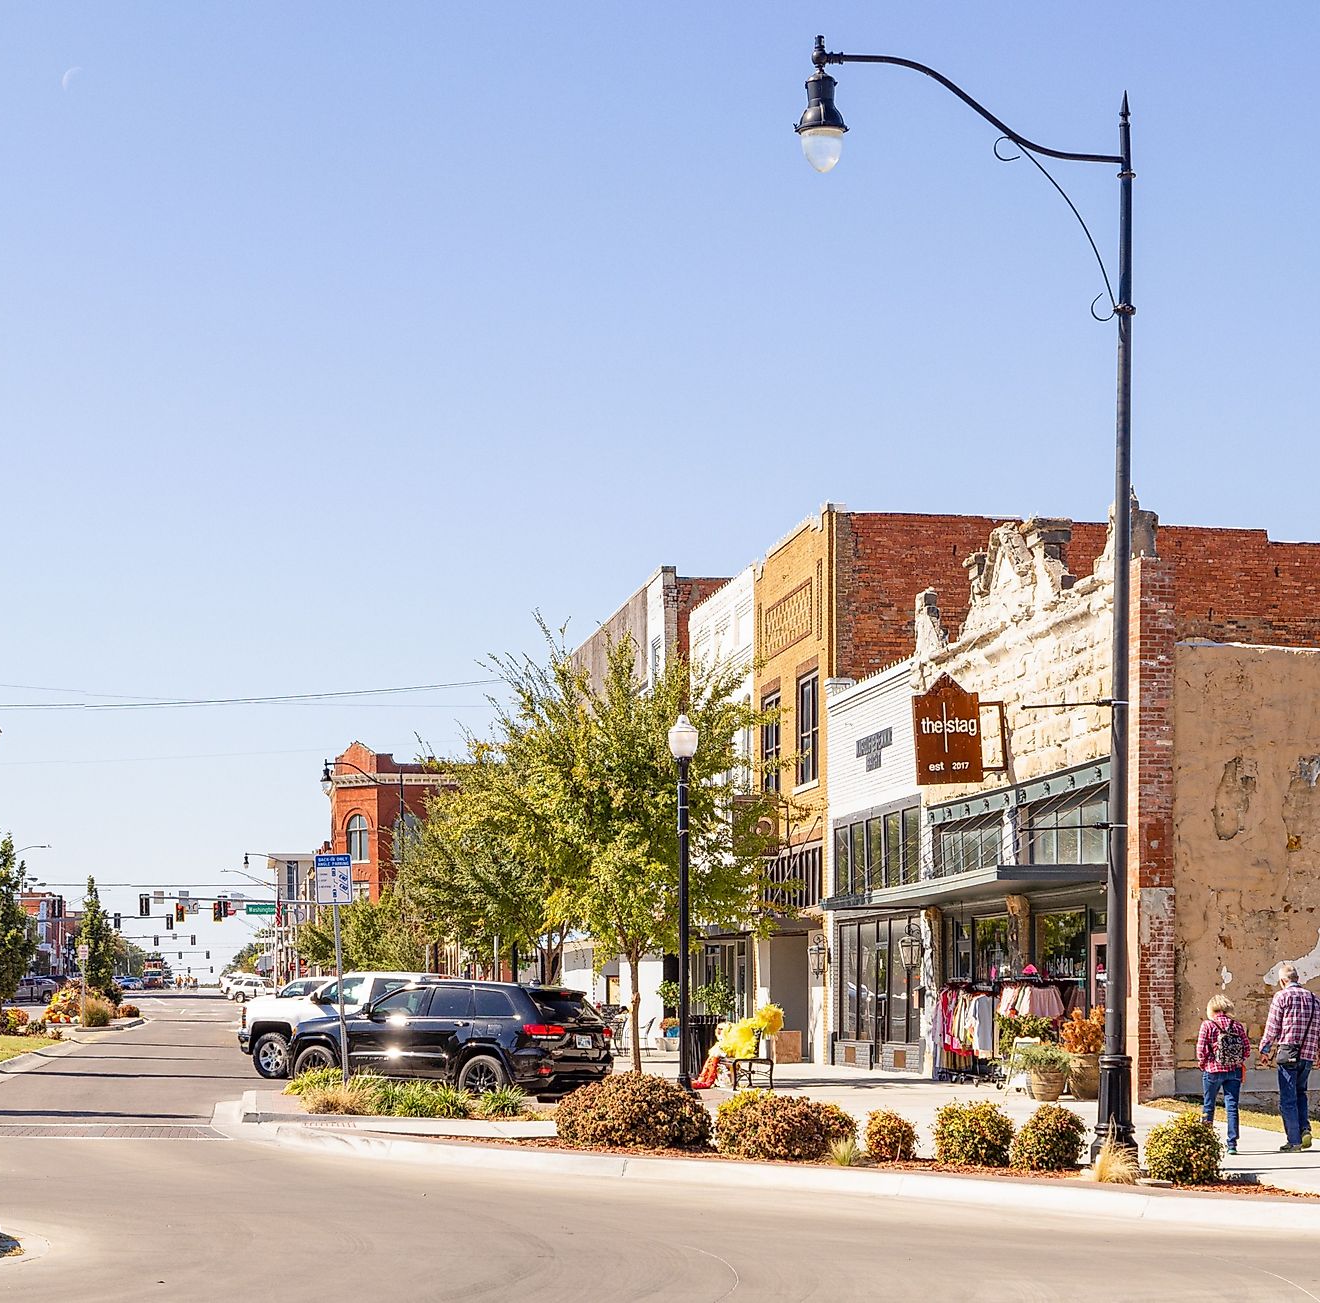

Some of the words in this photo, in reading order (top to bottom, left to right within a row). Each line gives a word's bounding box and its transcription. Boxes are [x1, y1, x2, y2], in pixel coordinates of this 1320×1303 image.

[921, 717, 943, 734] the
[946, 717, 977, 737] stag
[929, 762, 944, 771] est
[951, 761, 970, 770] 2017
